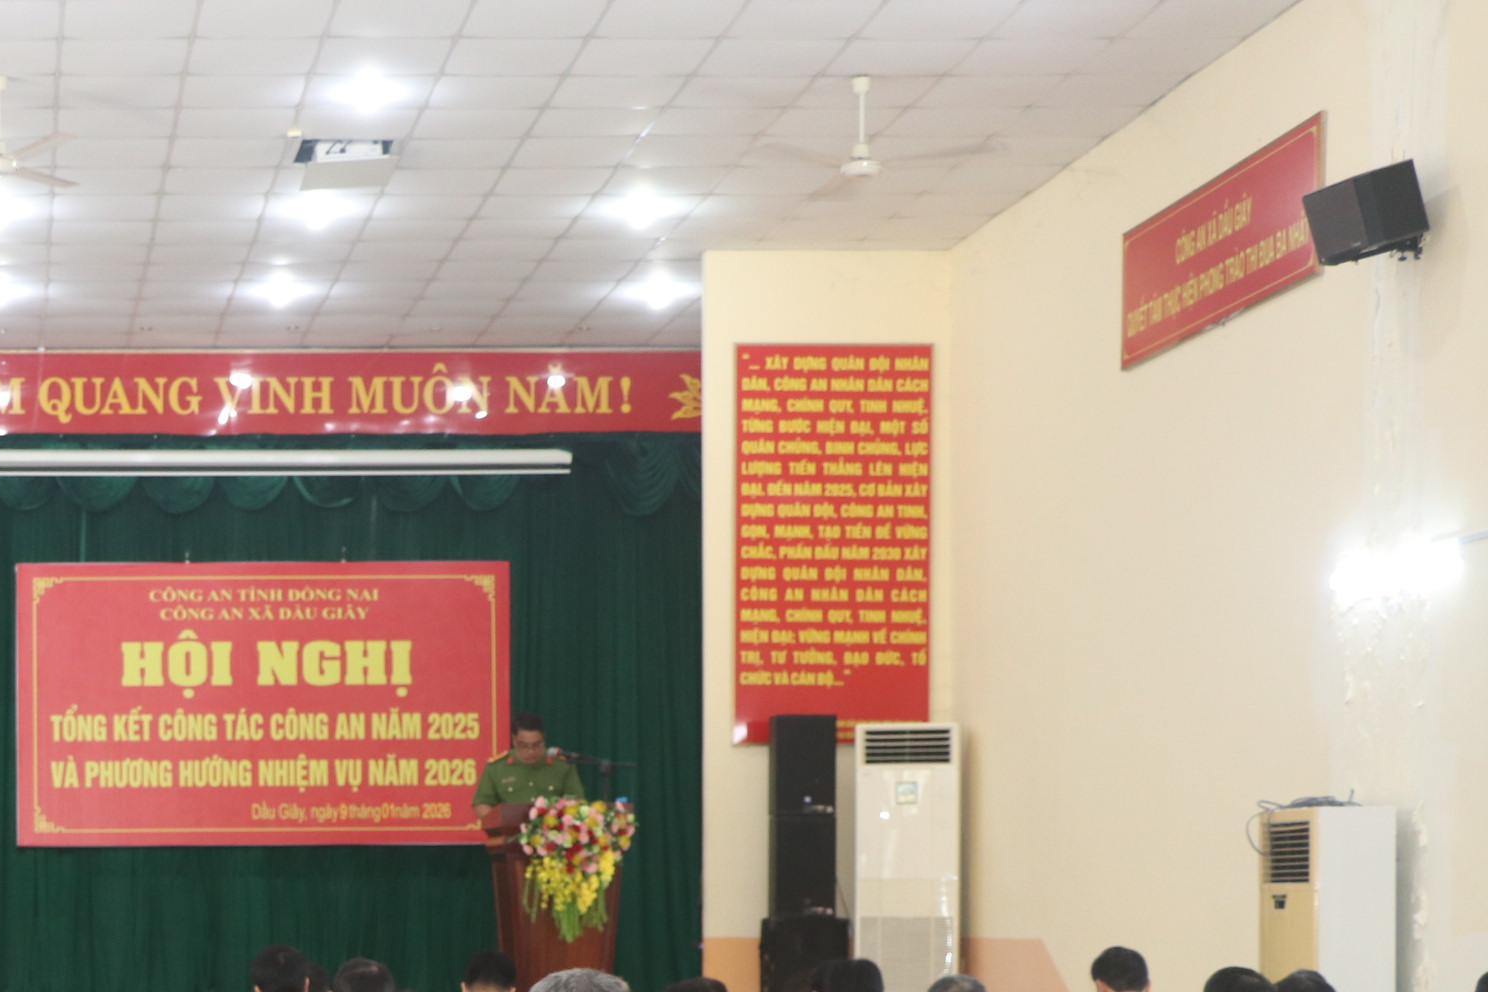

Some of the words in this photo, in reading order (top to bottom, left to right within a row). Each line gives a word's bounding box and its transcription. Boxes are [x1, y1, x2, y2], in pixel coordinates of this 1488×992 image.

[38, 375, 203, 423] QUANG
[214, 375, 334, 415] VINH
[348, 362, 492, 414] MUÔN
[505, 363, 632, 414] NĂM!
[149, 586, 203, 602] CÔNG
[208, 589, 232, 602] AN
[238, 587, 282, 601] TỈNH
[288, 587, 341, 601] ĐỒNG
[347, 589, 378, 600] NAI
[740, 586, 778, 601] CÔNG
[785, 588, 804, 601] AN
[811, 587, 848, 601] NHÂN
[856, 587, 884, 602] DÂN
[891, 588, 926, 602] CÁCH
[160, 605, 214, 620] CÔNG
[218, 608, 243, 620] AN
[249, 605, 274, 620] XÃ
[280, 606, 318, 620] DẦU
[322, 604, 370, 619] GIÂY
[121, 629, 232, 698] HỘI
[257, 640, 412, 696] NGHỊ
[50, 704, 107, 742] TỔNG
[113, 706, 153, 741] KẾT
[158, 708, 217, 741] CÔNG
[223, 708, 264, 740] TÁC
[270, 708, 328, 740] CÔNG
[335, 713, 365, 739] AN
[372, 708, 421, 739] NĂM
[428, 713, 479, 739] 2025
[50, 755, 80, 788] VÀ
[84, 758, 173, 788] PHƯƠNG
[179, 754, 252, 787] HƯỚNG
[258, 754, 328, 792] NHIỆM
[335, 759, 362, 791] VỤ
[369, 755, 418, 785] NĂM
[425, 759, 476, 785] 2026
[310, 804, 339, 823] ngày
[340, 804, 348, 819] 9
[422, 803, 452, 819] 2026
